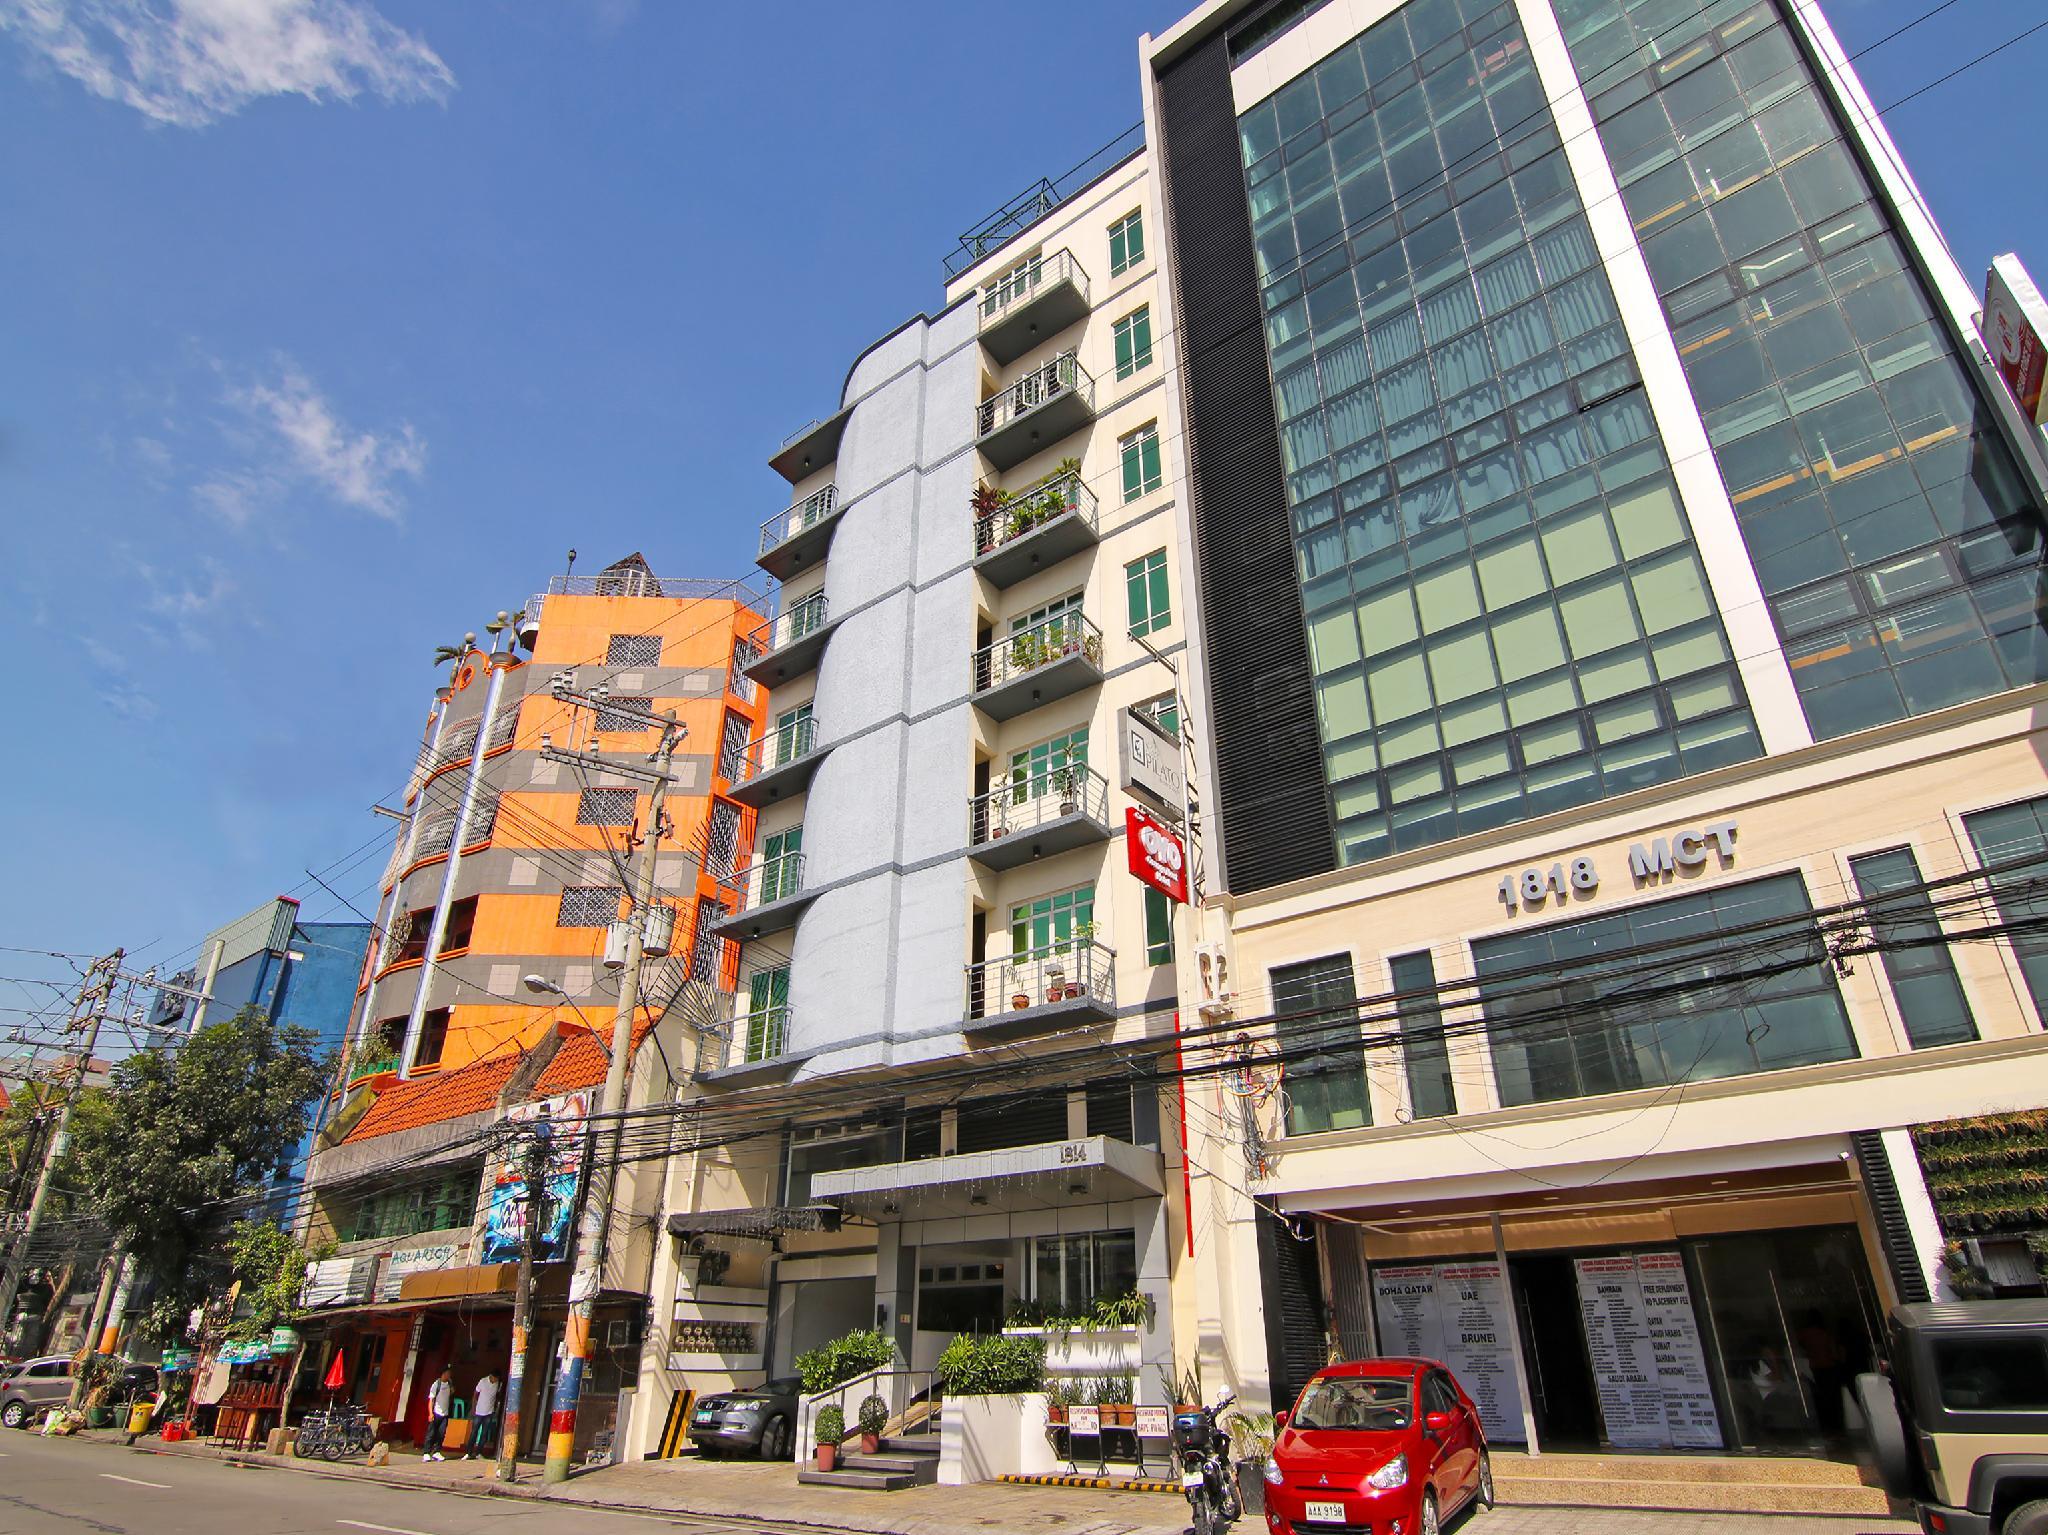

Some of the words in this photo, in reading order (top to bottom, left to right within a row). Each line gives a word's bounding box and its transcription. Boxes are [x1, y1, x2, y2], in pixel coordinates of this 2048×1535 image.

[1498, 856, 1599, 908] 1818
[1628, 820, 1739, 878] MCT
[1061, 1144, 1087, 1163] 1814
[1380, 1287, 1402, 1296] DOHA
[1404, 1285, 1433, 1294] QATAR
[1461, 1291, 1478, 1300] UAE
[1461, 1333, 1497, 1343] BRUNEI
[1626, 1374, 1648, 1382] ARABIA
